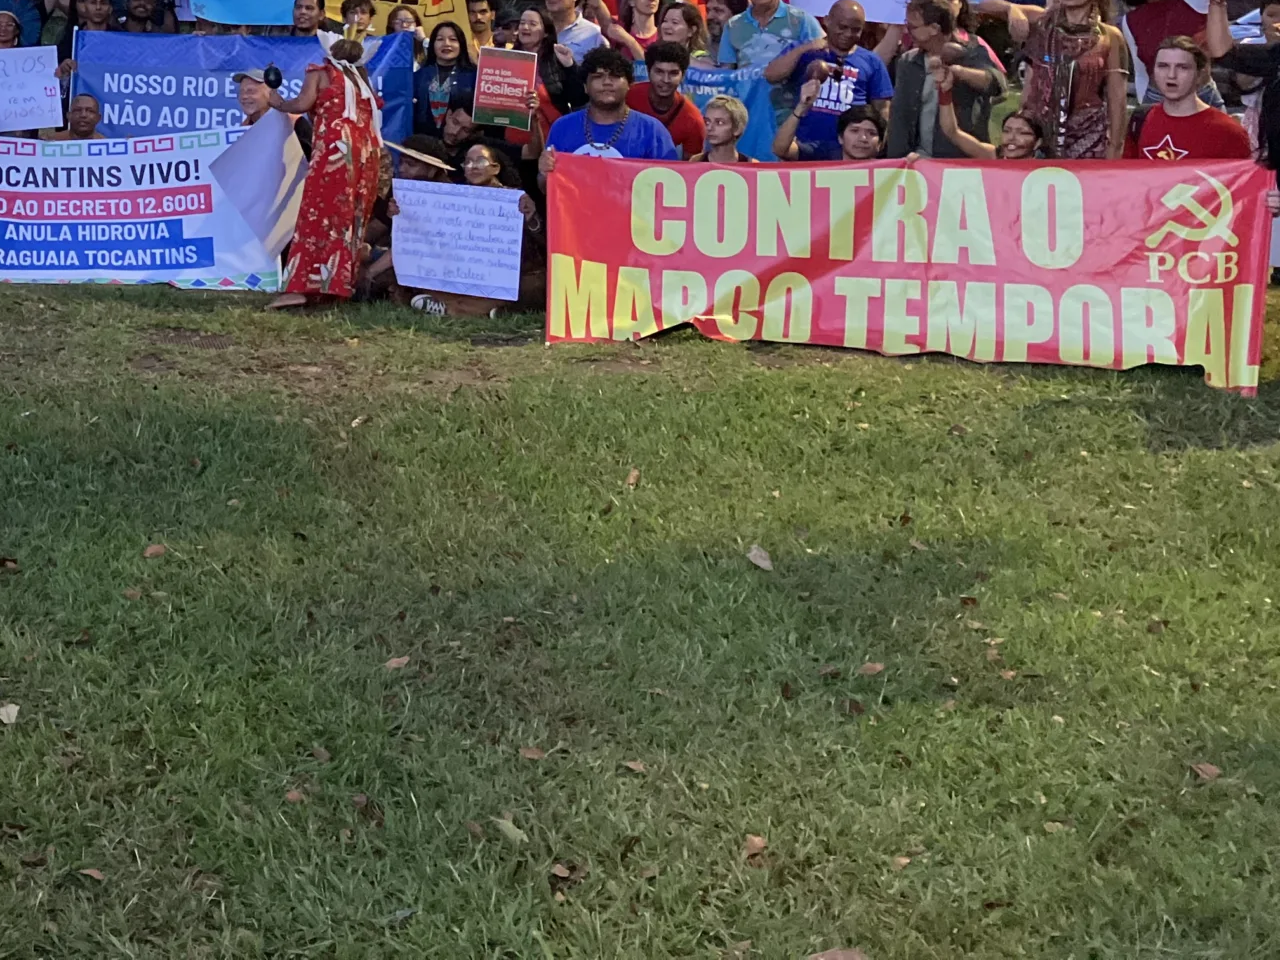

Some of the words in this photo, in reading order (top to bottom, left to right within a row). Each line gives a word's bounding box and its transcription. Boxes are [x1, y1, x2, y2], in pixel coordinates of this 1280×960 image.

[103, 72, 177, 96] NOSSO
[182, 75, 219, 97] RIO
[103, 100, 151, 127] NÃO
[157, 107, 188, 128] AO
[130, 159, 200, 186] VIVO!
[12, 199, 38, 216] AO
[43, 199, 132, 216] DECRETO
[136, 192, 206, 215] 12.600!
[631, 167, 996, 266] CONTRA
[1021, 166, 1084, 269] O
[4, 224, 72, 241] ANULA
[77, 222, 170, 241] HIDROVIA
[84, 245, 197, 266] TOCANTINS
[1144, 251, 1239, 284] PCB
[549, 252, 813, 342] MARCO
[835, 277, 1259, 389] TEMPORAL
